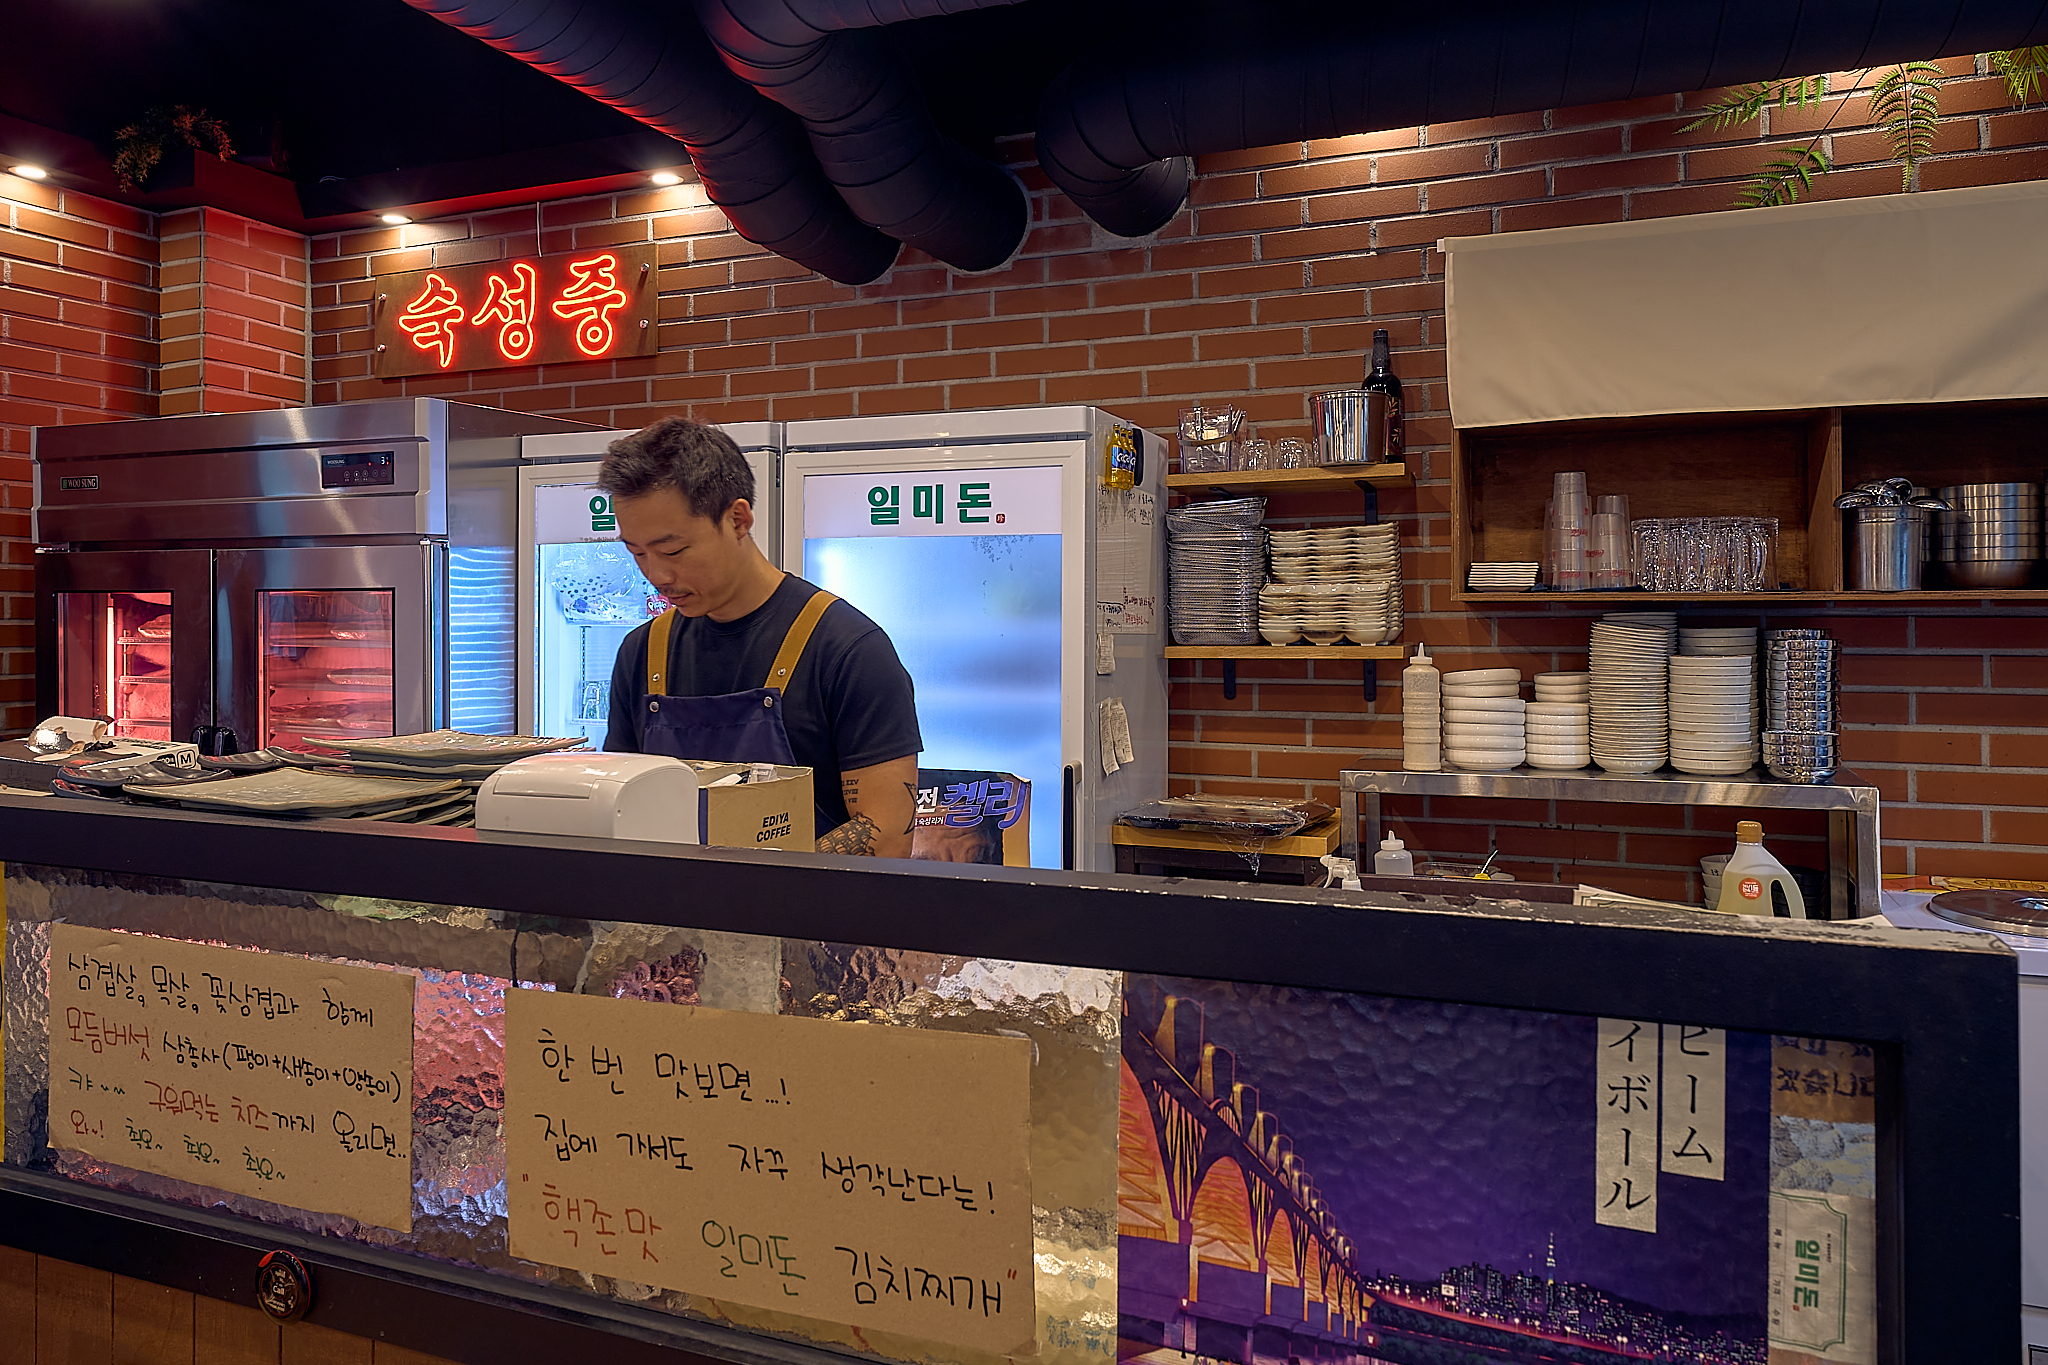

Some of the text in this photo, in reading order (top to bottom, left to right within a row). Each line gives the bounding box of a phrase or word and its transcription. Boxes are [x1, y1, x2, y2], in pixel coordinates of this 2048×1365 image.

[398, 252, 628, 369] 숙성중
[867, 482, 993, 526] 일미돈
[180, 753, 192, 765] M
[762, 812, 789, 828] EDIYA
[916, 786, 939, 814] 전
[756, 824, 792, 843] COFFEE
[66, 1006, 150, 1062] 모듬버섯
[321, 987, 374, 1028] 함께
[144, 1080, 219, 1123] 구워먹는
[231, 1095, 315, 1134] 치즈까지
[1602, 1022, 1652, 1211] イボール
[534, 1113, 598, 1162] 집에
[616, 1132, 694, 1171] 가서도
[727, 1143, 789, 1181] 자꾸
[702, 1219, 807, 1296] 일미돈
[1793, 1239, 1821, 1309] 일미돈
